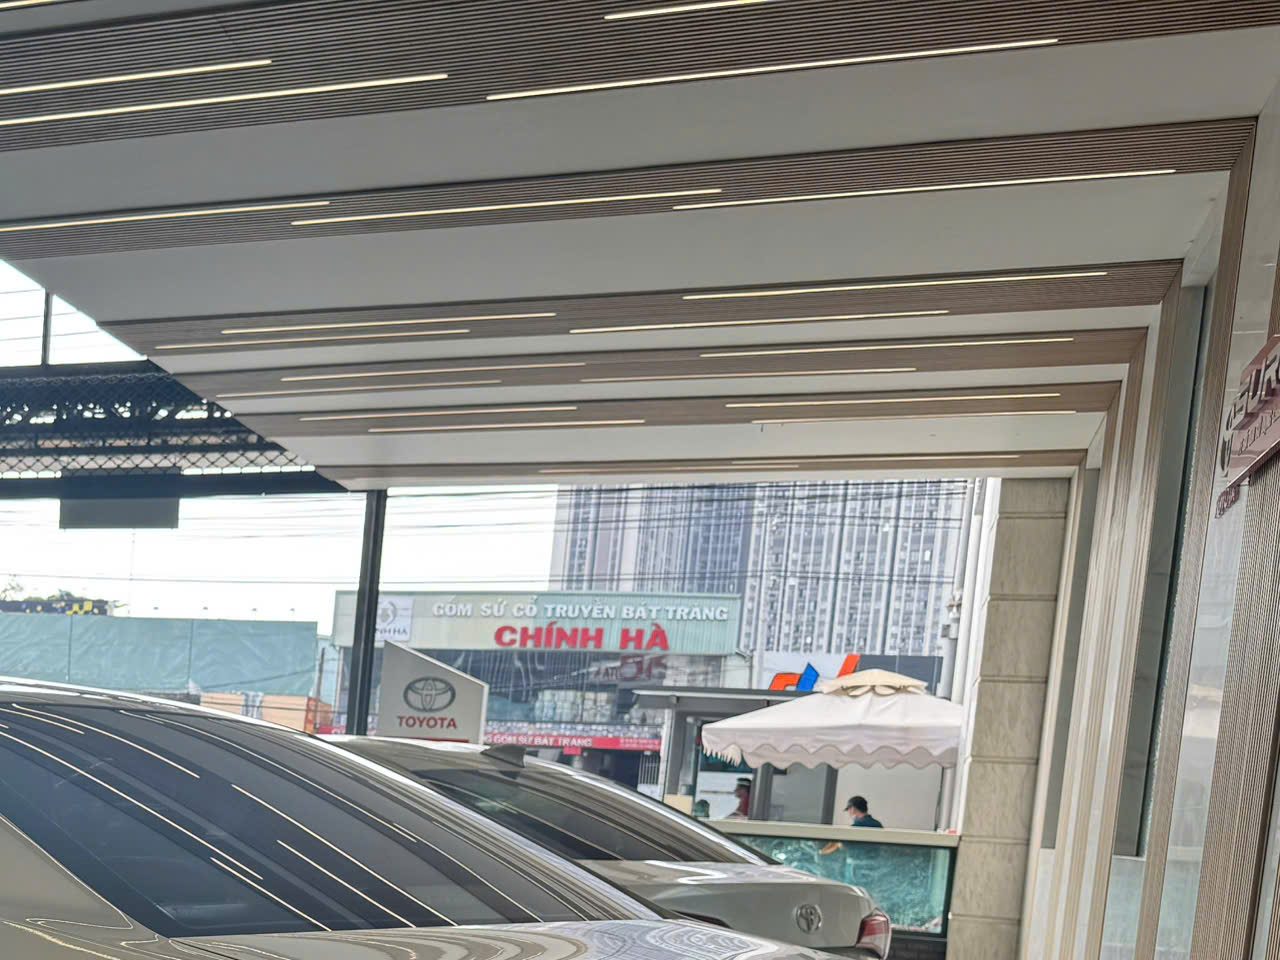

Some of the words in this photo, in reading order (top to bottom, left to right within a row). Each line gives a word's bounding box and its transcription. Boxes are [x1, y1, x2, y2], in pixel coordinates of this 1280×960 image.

[480, 598, 507, 617] SỨ
[622, 601, 662, 620] BÁT
[494, 621, 604, 648] CHÍNH
[620, 622, 669, 651] HÀ
[397, 715, 457, 729] TOYOTA
